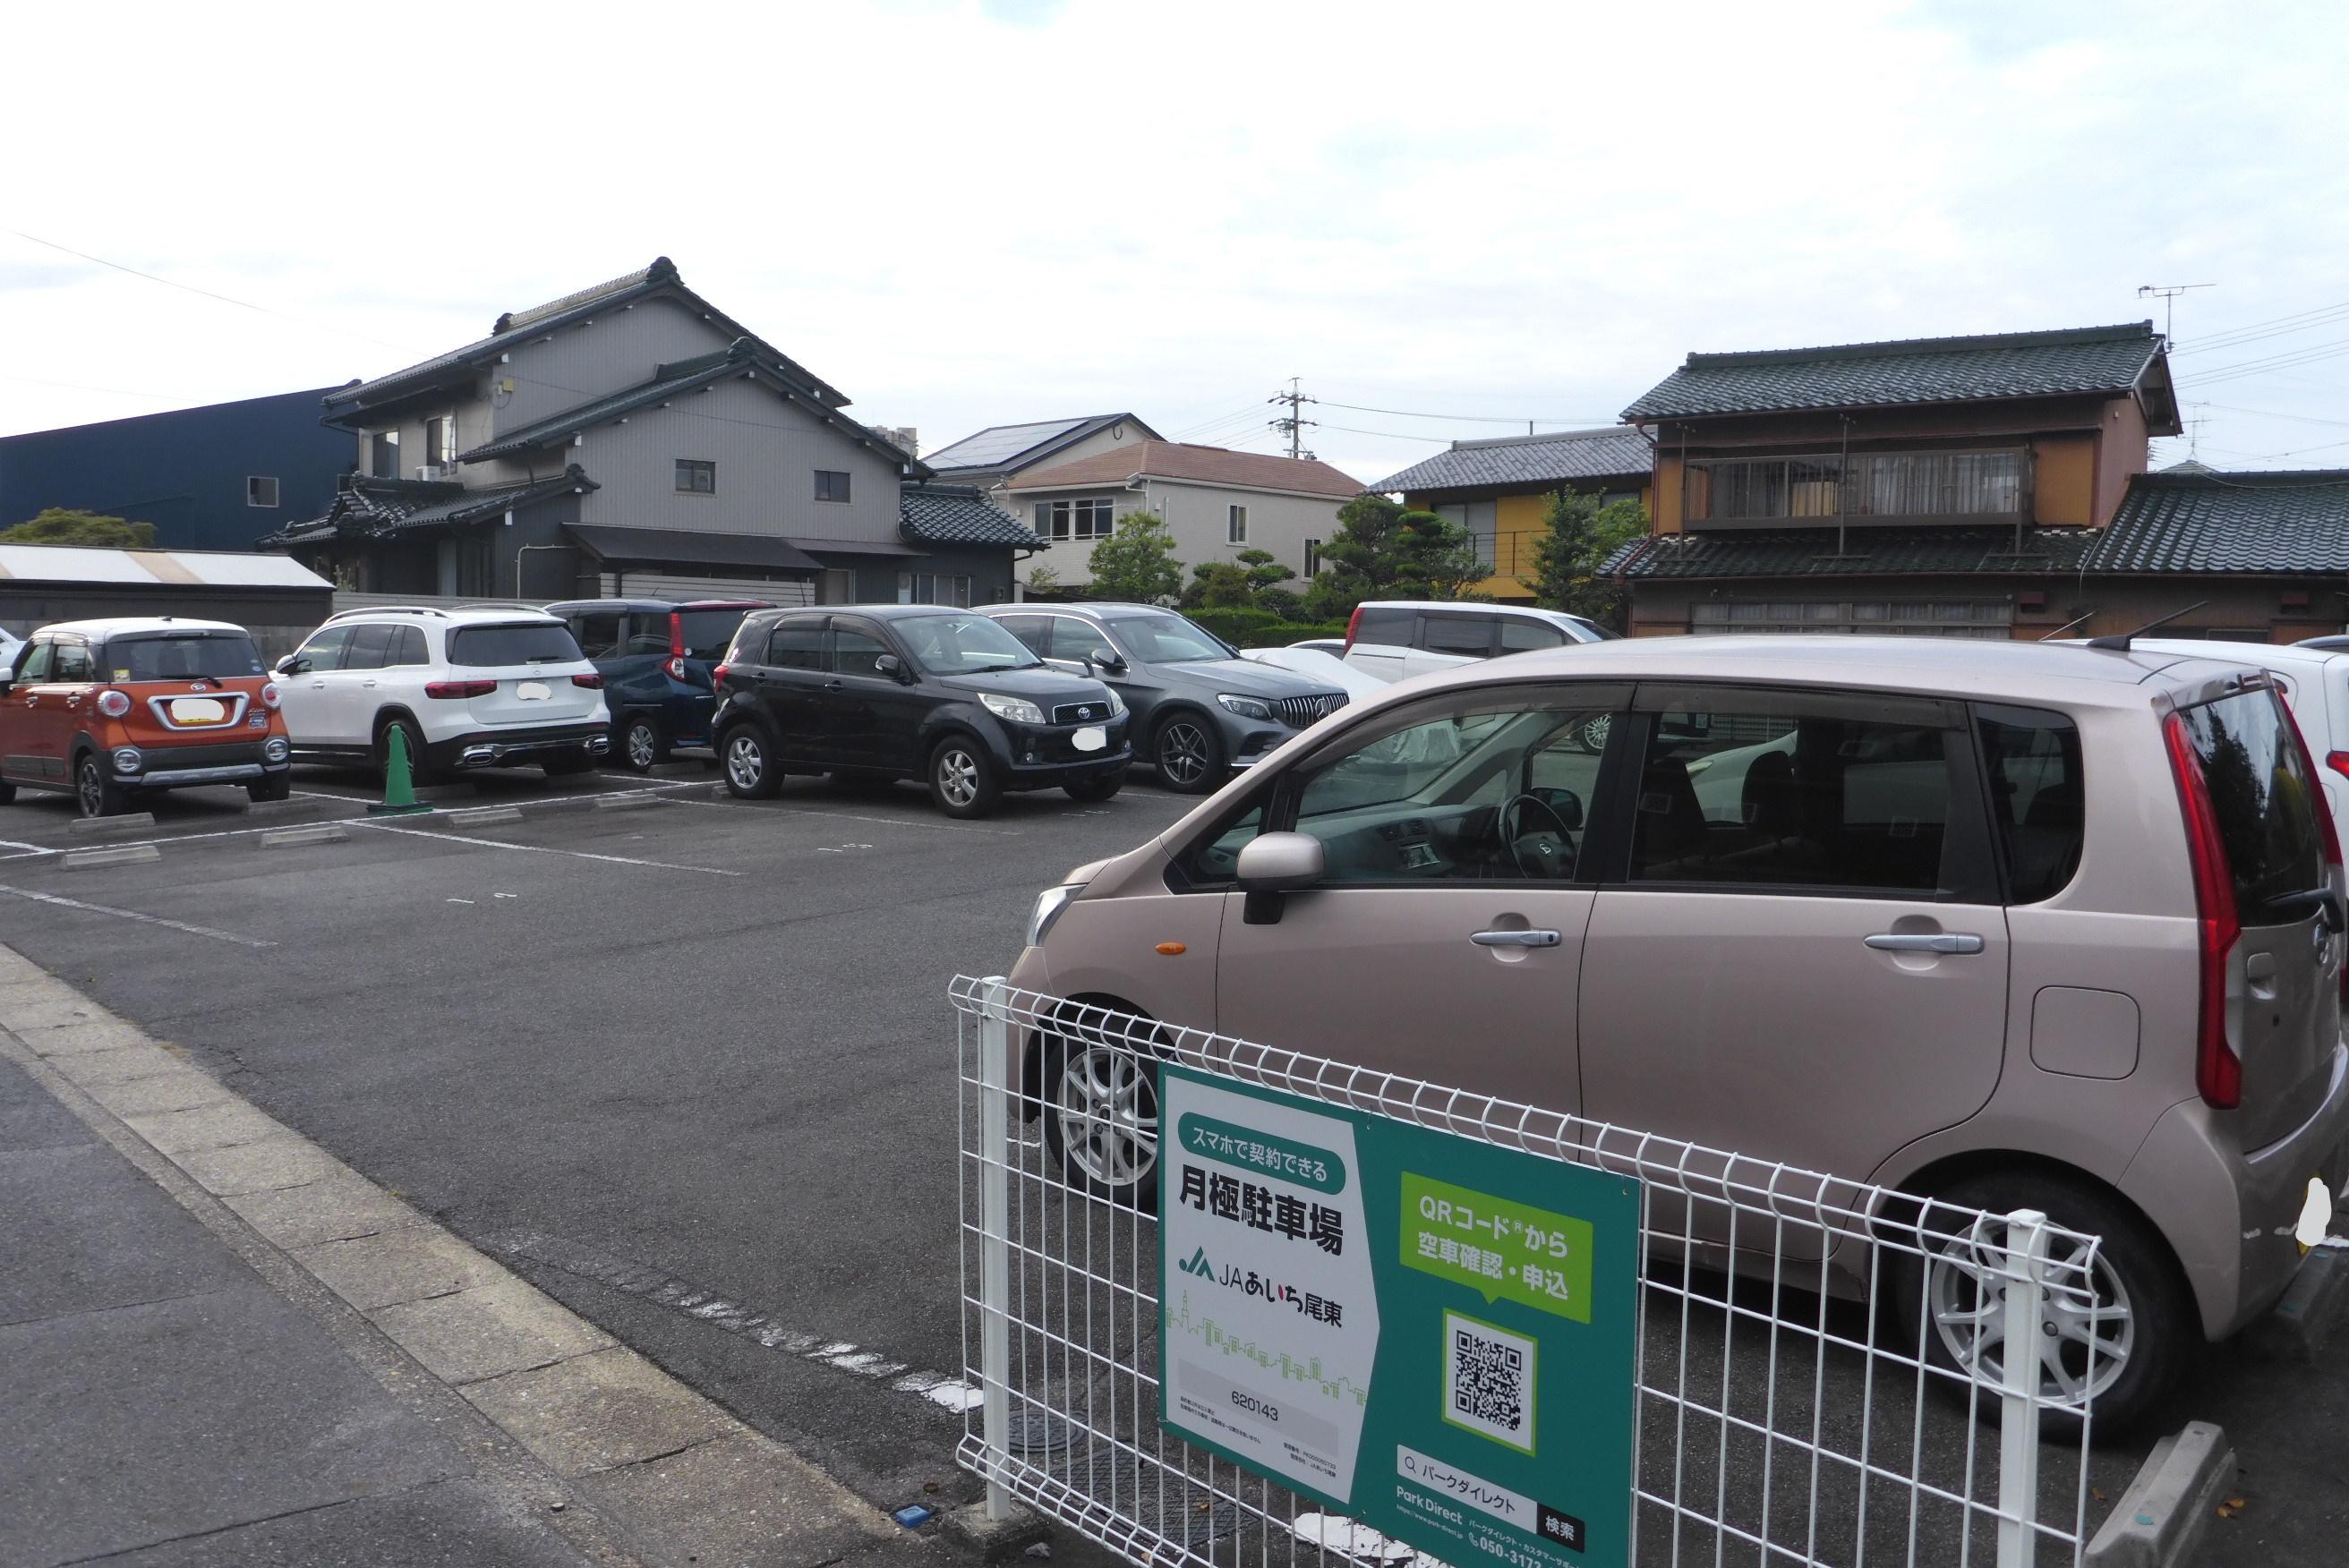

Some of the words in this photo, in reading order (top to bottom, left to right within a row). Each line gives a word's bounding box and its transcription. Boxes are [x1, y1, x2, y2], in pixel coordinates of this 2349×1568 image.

[1192, 1127, 1328, 1182] スマホで契約できる
[1179, 1163, 1344, 1257] 月極駐車場
[1417, 1231, 1568, 1300] 空車確認・申込
[1218, 1263, 1343, 1328] JAあいち尾東
[1231, 1390, 1278, 1422] 620143
[1397, 1485, 1424, 1508] Park
[1425, 1496, 1464, 1525] Direct
[1422, 1464, 1516, 1514] パークダイレクト
[1544, 1514, 1576, 1542] 検索
